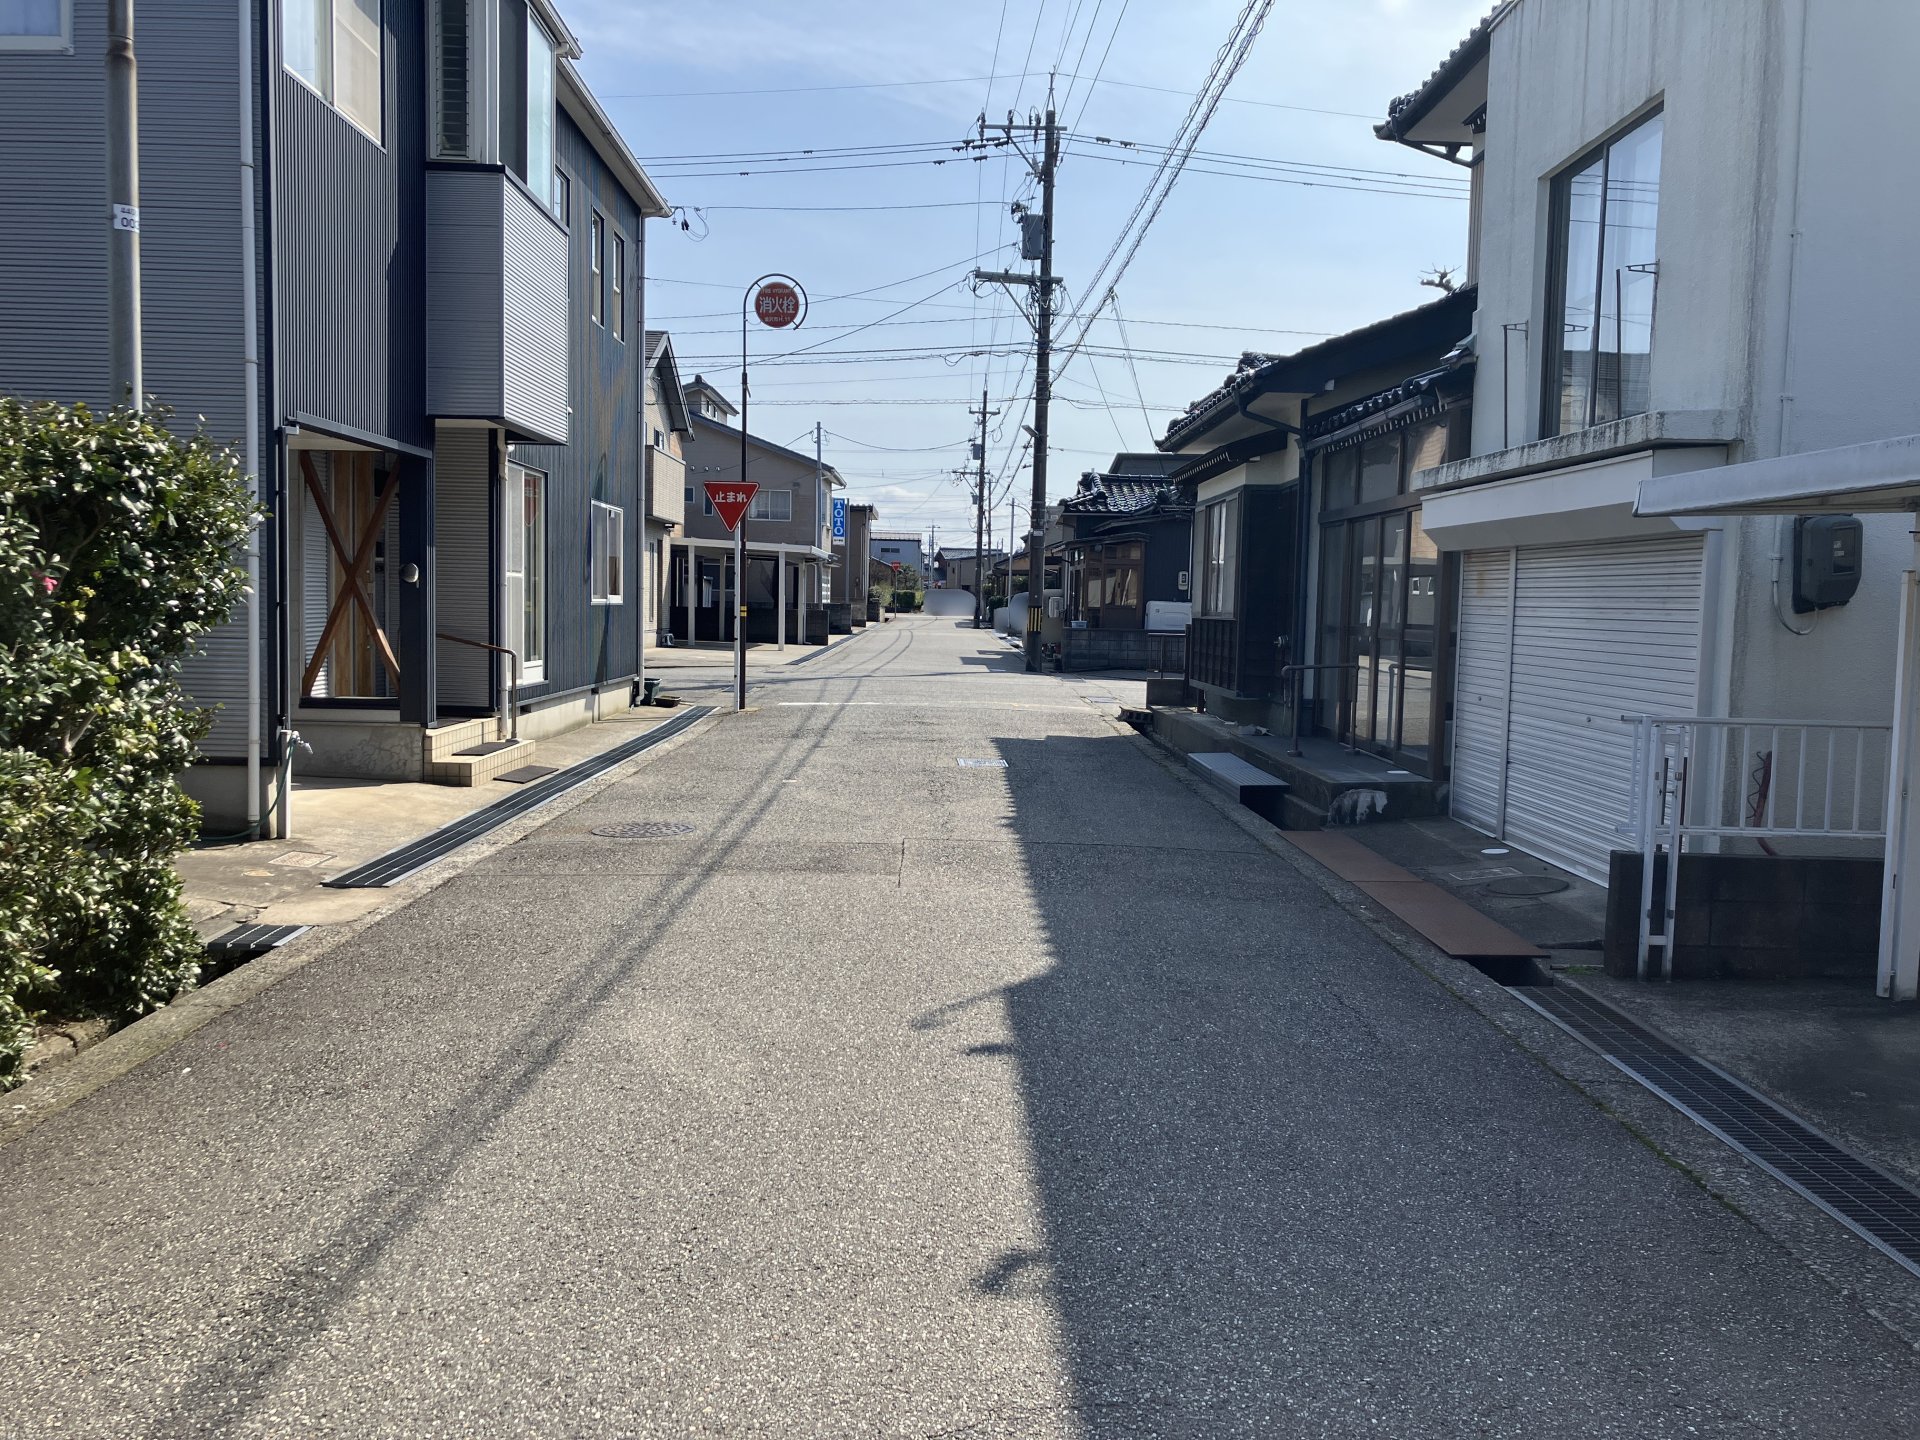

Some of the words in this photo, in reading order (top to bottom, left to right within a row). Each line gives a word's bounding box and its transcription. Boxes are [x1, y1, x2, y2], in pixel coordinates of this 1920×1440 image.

[759, 296, 796, 314] 消火栓
[714, 491, 748, 503] 止まれ
[834, 499, 844, 535] TOTO
